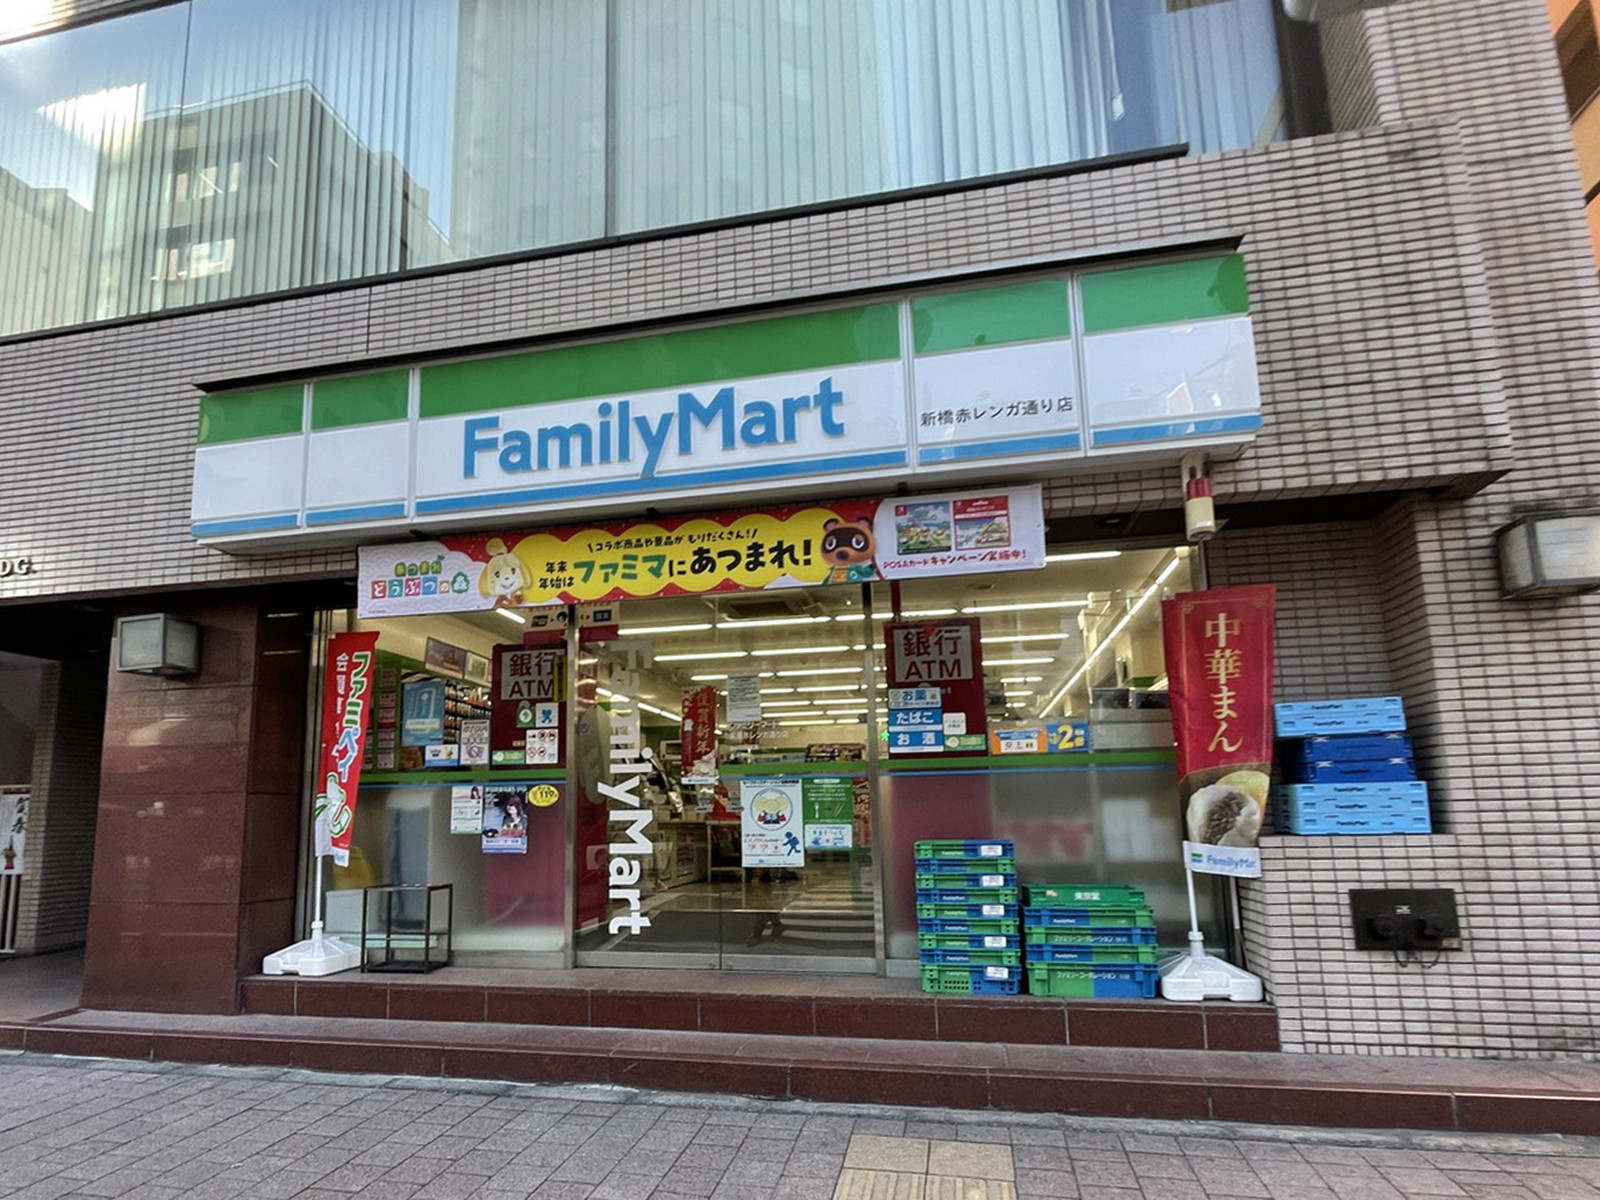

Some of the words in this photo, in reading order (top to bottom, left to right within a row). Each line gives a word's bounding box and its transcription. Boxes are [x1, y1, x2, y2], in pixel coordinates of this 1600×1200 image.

[920, 396, 1074, 427] 新橋赤レンガ通り店
[464, 376, 844, 478] FamilyMart
[545, 562, 568, 574] 年末
[573, 539, 812, 583] ファミマにあつまれ!
[538, 576, 575, 589] 年始は
[903, 629, 962, 657] 銀行
[509, 652, 554, 677] 銀行
[904, 659, 962, 680] ATM
[509, 680, 554, 698] ATM
[1204, 613, 1243, 753] 中華まん
[896, 711, 934, 724] たばこ
[597, 641, 653, 935] FamilyMart
